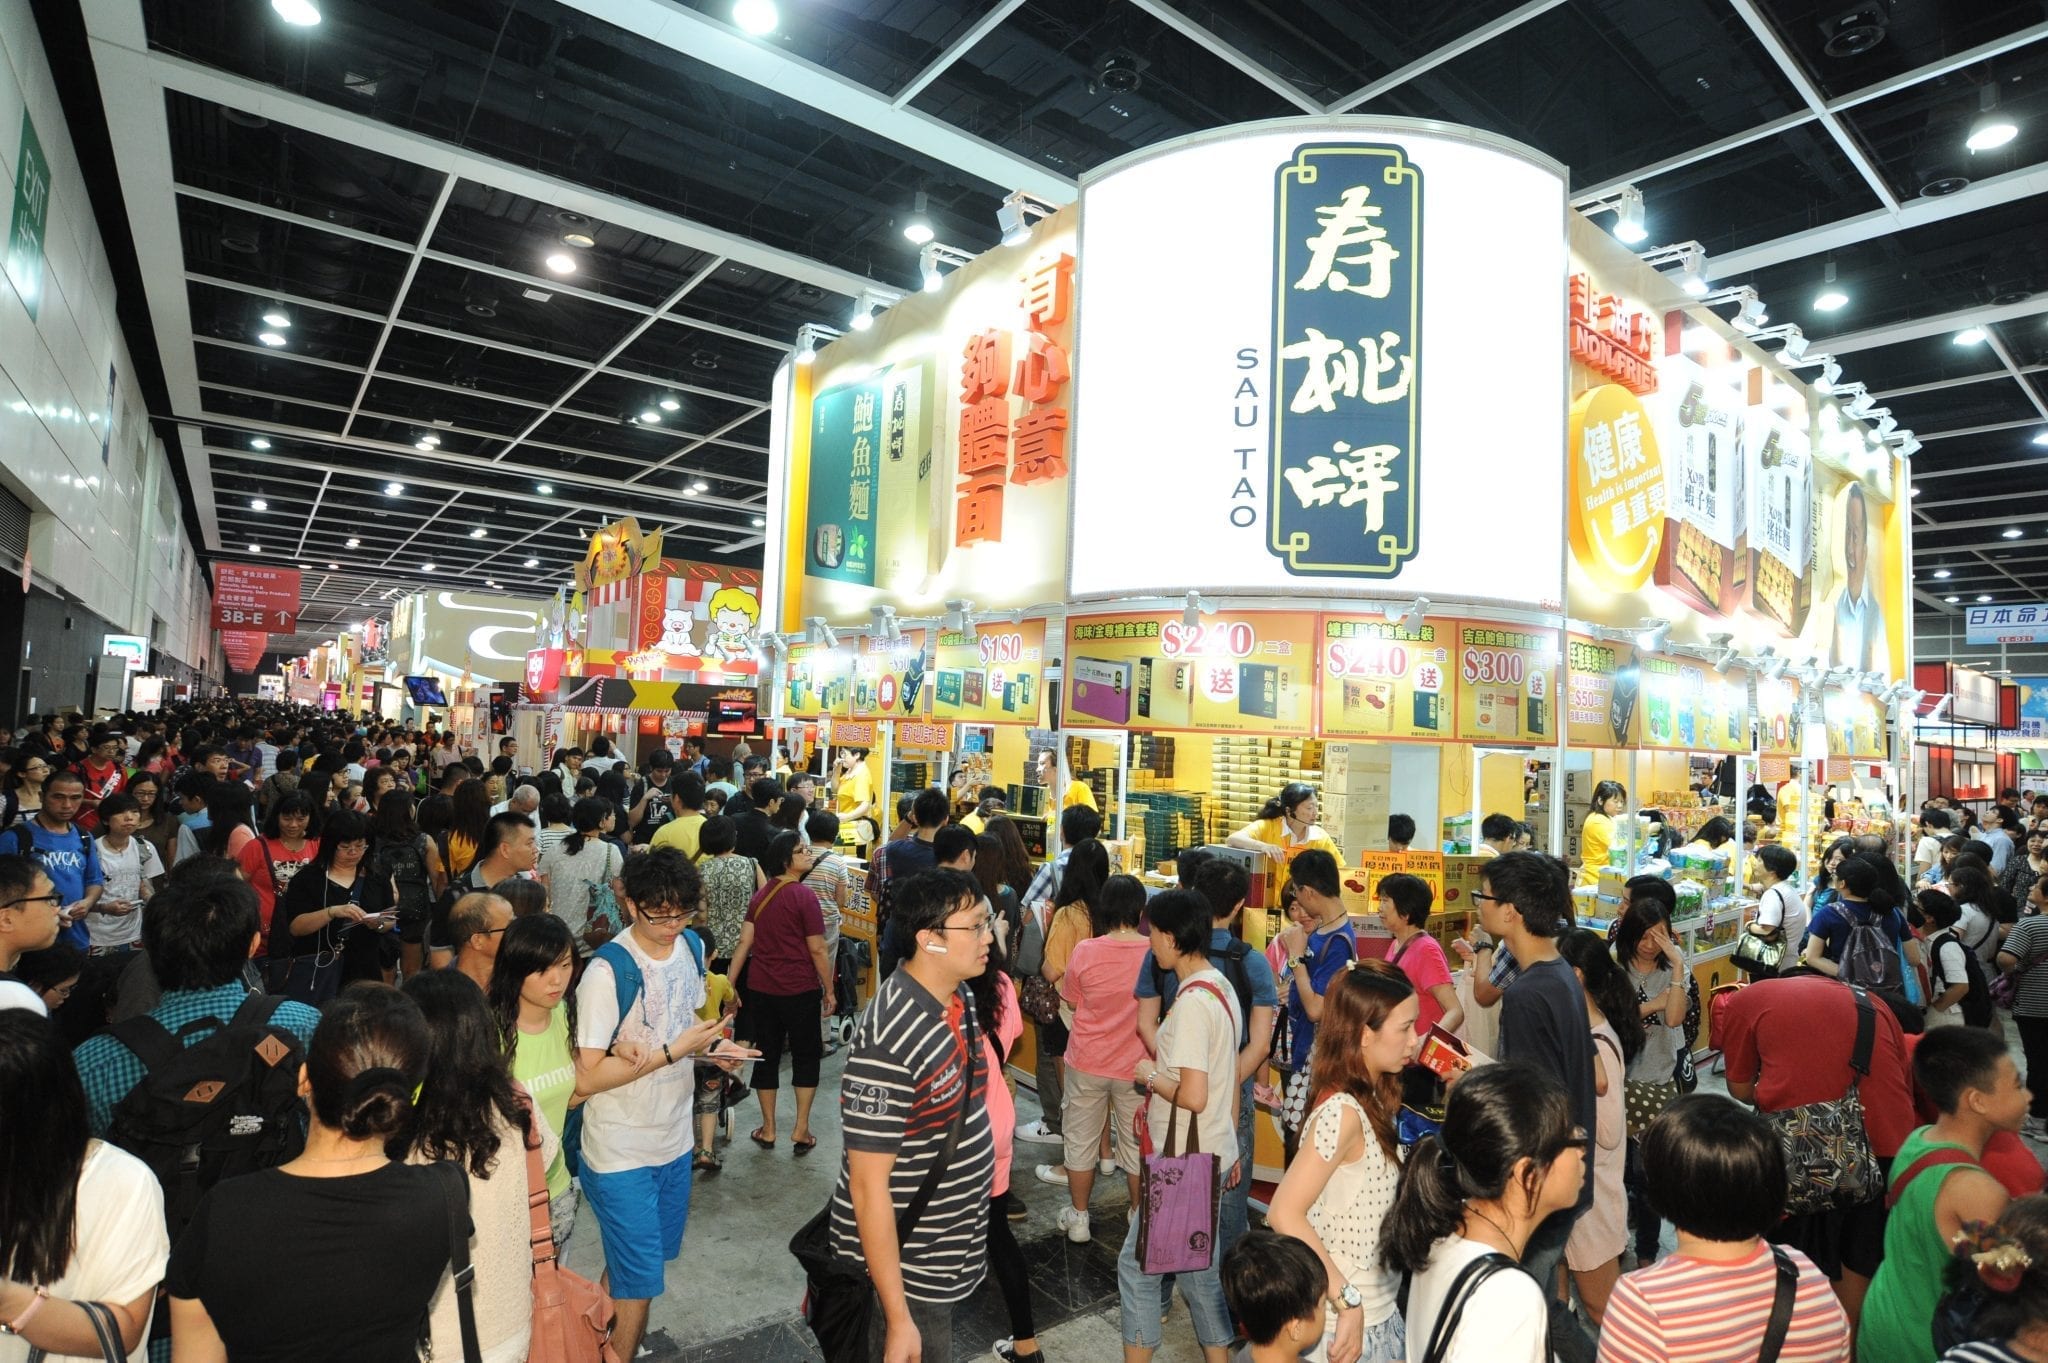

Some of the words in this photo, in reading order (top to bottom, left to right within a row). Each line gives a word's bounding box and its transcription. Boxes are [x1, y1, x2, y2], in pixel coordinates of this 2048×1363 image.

[1574, 323, 1660, 395] NON-FRIED
[1234, 347, 1259, 428] SAU
[1583, 409, 1647, 488] 健康
[1229, 447, 1258, 529] TAO
[1586, 486, 1616, 512] Health
[1615, 482, 1625, 497] is
[1623, 464, 1662, 492] important
[1611, 481, 1664, 539] 最重要
[221, 609, 264, 625] 3B-E
[979, 633, 1023, 665] $180
[1463, 646, 1524, 684] $300
[991, 672, 1002, 693] 送
[1210, 667, 1235, 695] 送
[1420, 667, 1438, 690] 送
[1531, 676, 1544, 696] 送
[850, 1082, 889, 1117] 73
